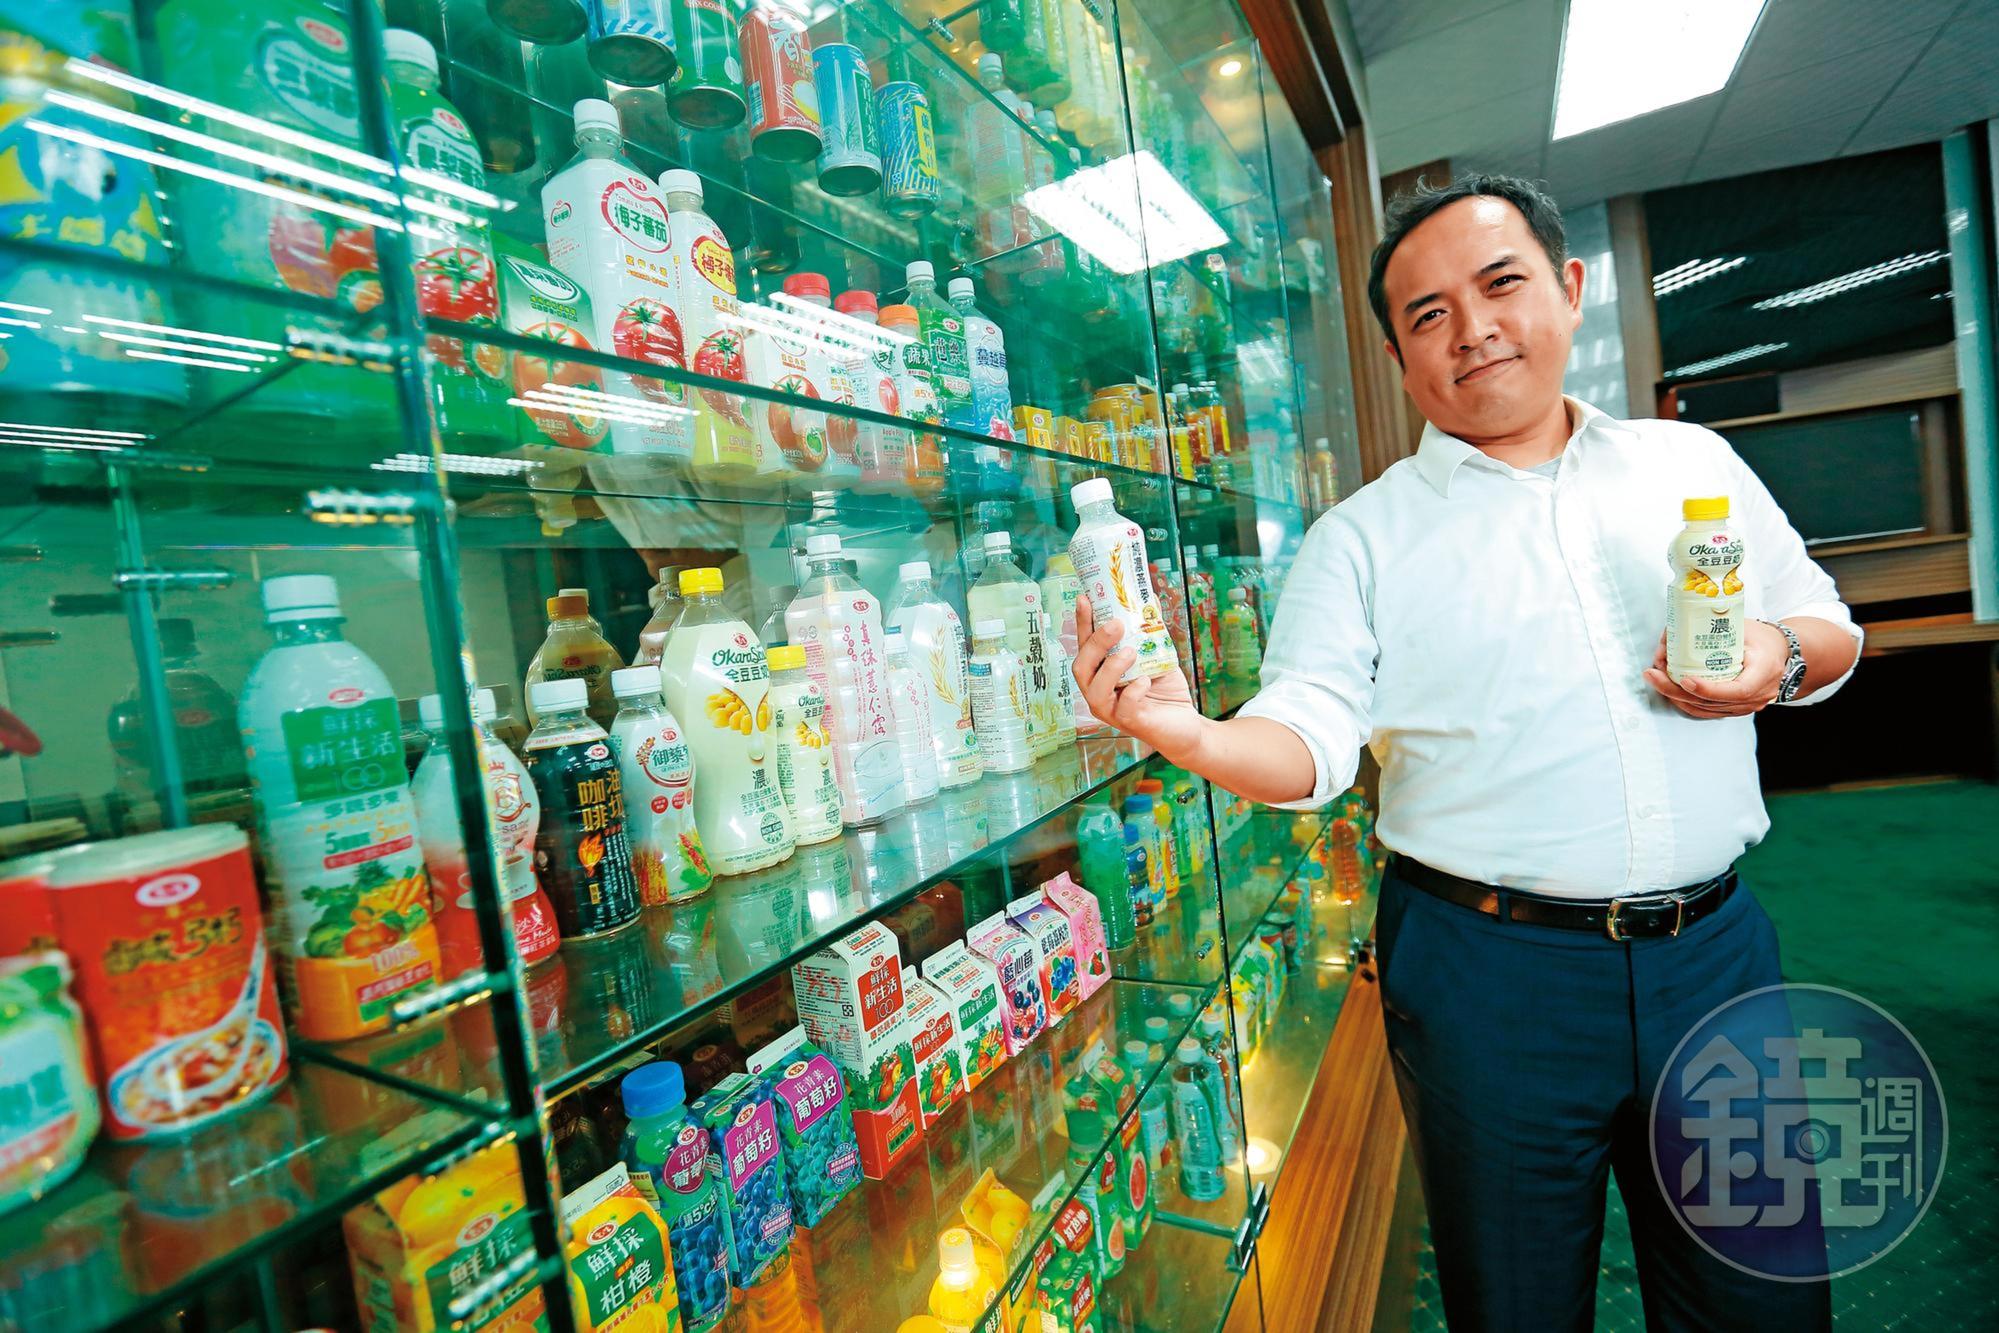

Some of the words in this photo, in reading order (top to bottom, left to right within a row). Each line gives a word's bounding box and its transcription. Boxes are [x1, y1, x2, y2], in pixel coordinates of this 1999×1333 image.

[1689, 544, 1743, 555] OkaaSo
[577, 778, 608, 833] 咖啡
[864, 976, 898, 1010] 新生活
[794, 1075, 837, 1122] 葡萄籽
[732, 1127, 773, 1179] 葡萄籽
[587, 1227, 644, 1274] 鮮採
[600, 1259, 653, 1315] 柑橙
